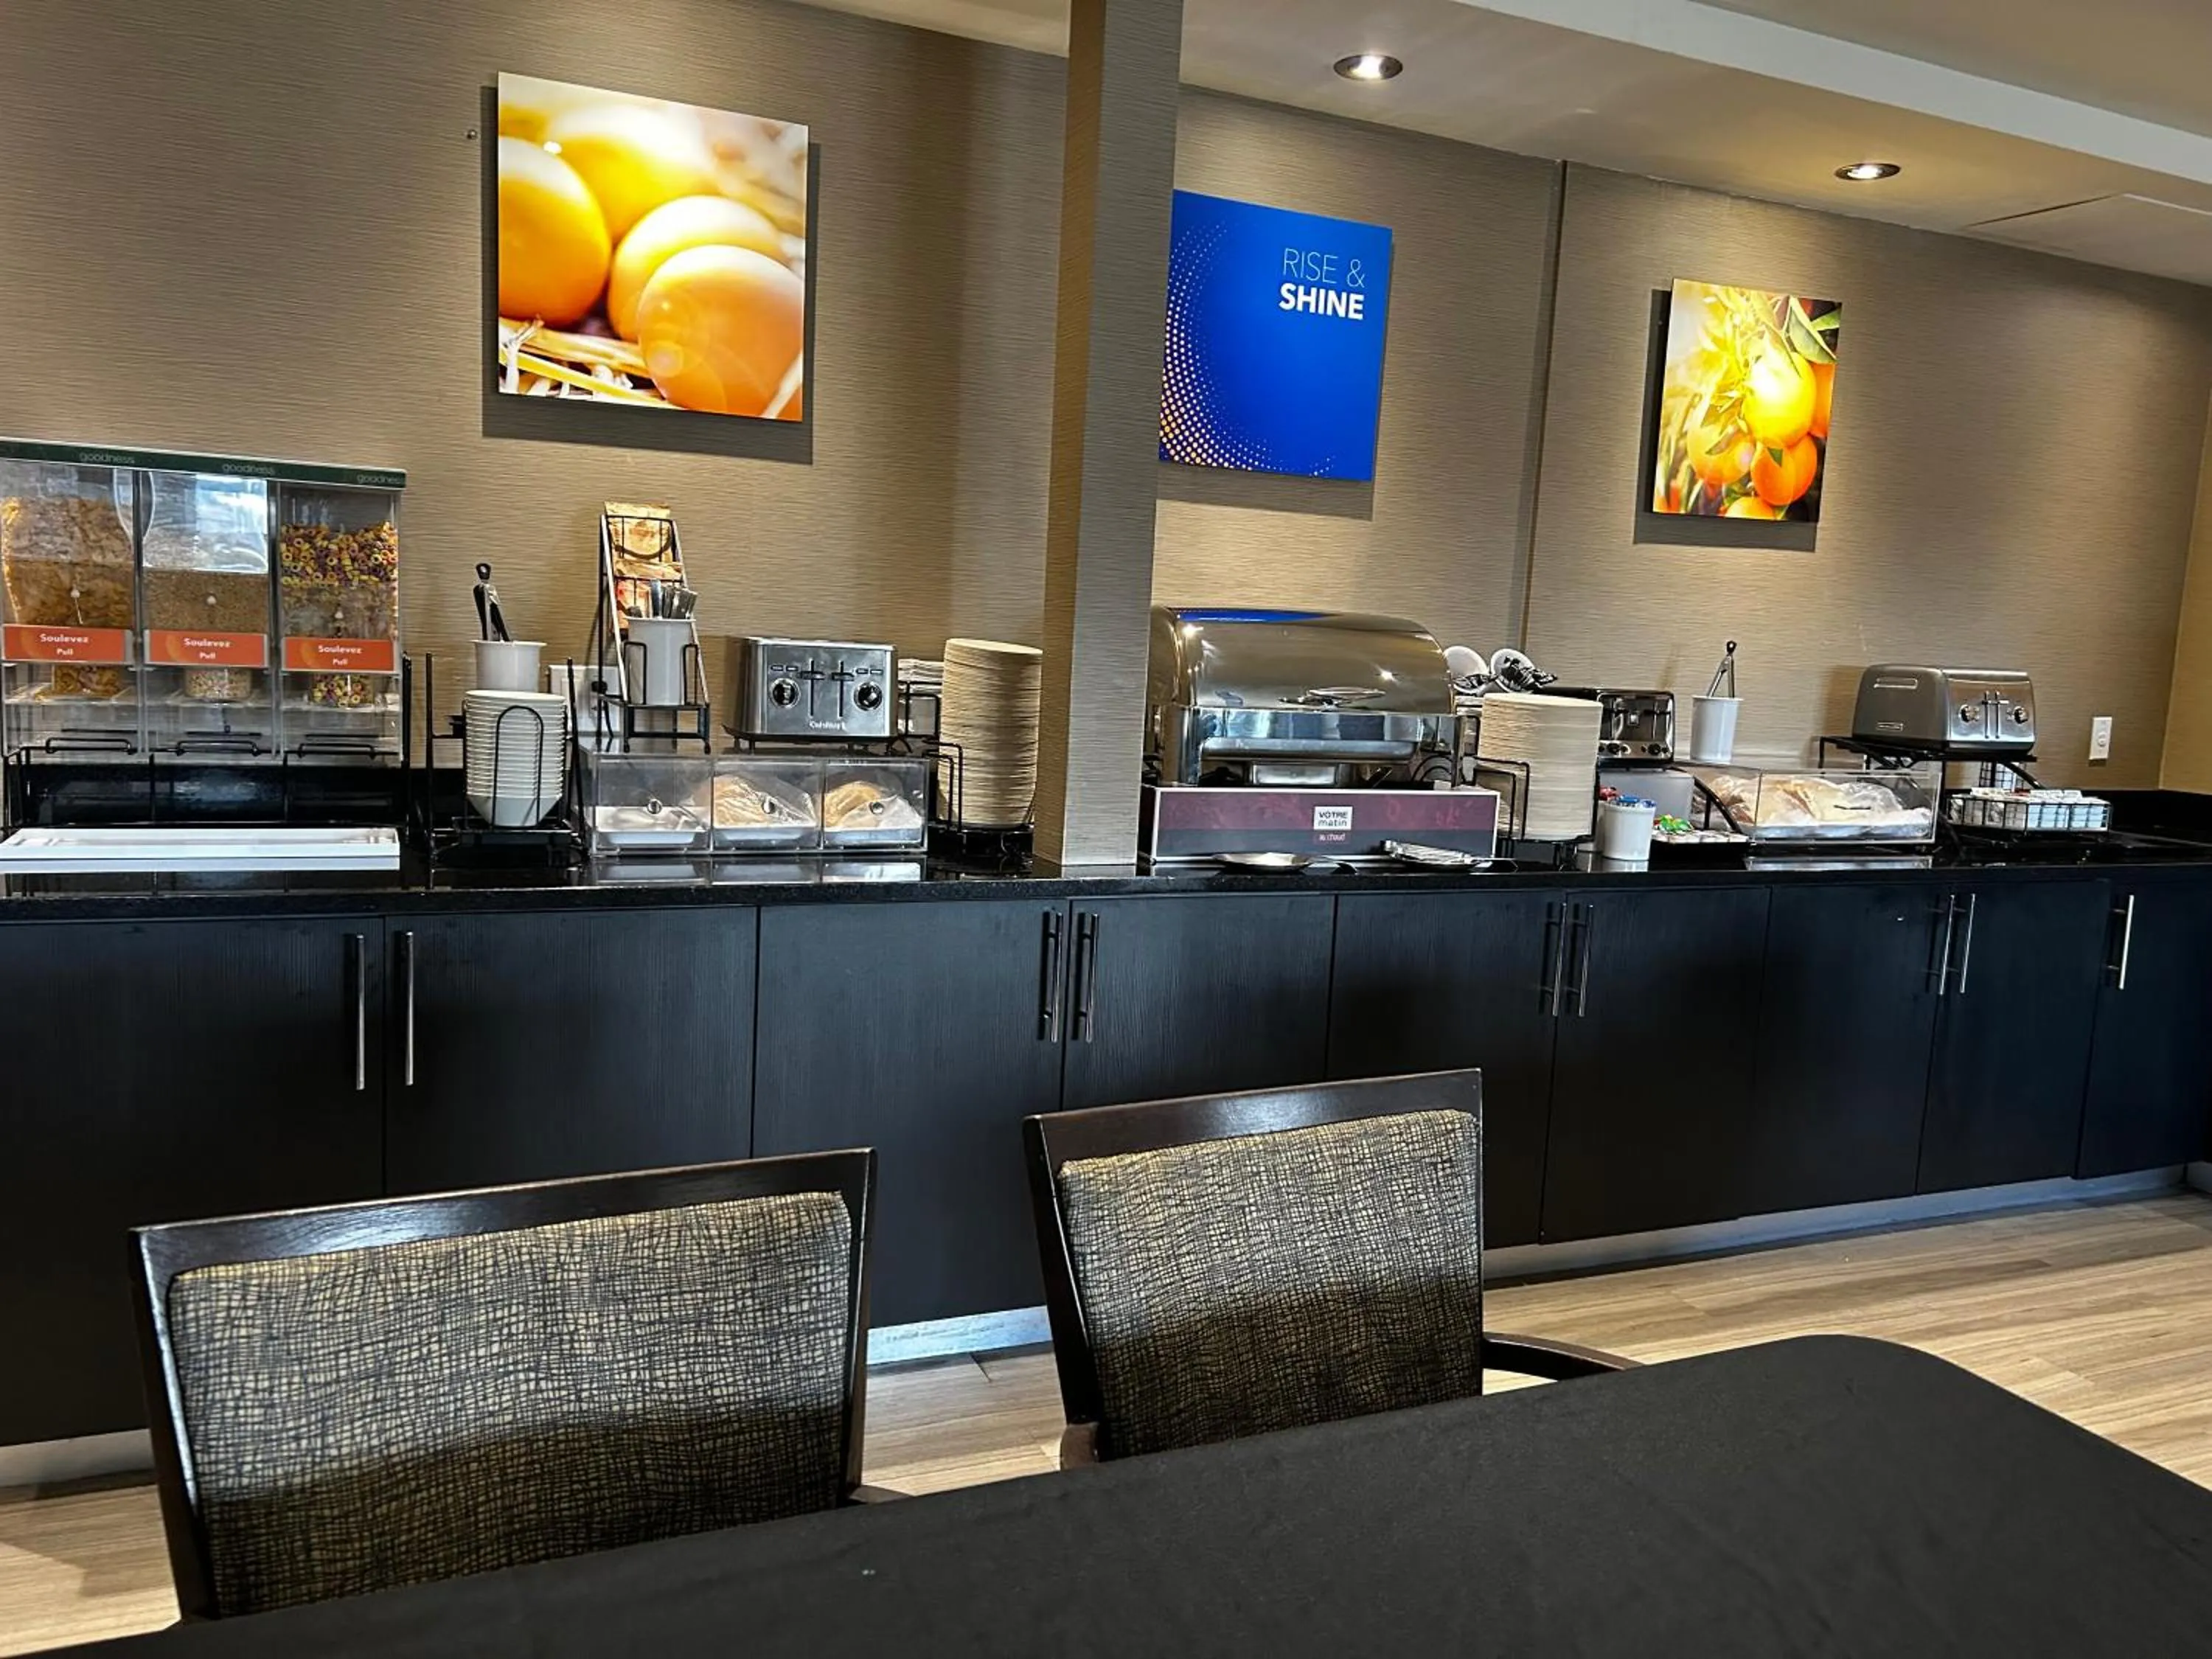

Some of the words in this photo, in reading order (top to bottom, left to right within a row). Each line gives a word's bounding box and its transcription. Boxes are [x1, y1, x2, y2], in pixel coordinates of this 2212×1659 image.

[1283, 248, 1338, 284] RISE
[1346, 259, 1366, 288] &
[1279, 282, 1364, 320] SHINE
[40, 633, 89, 644] Soulevez
[184, 638, 231, 648] Soulevez
[57, 647, 73, 655] Pull
[318, 644, 362, 654] Soulevez
[1319, 811, 1348, 819] VOTRE
